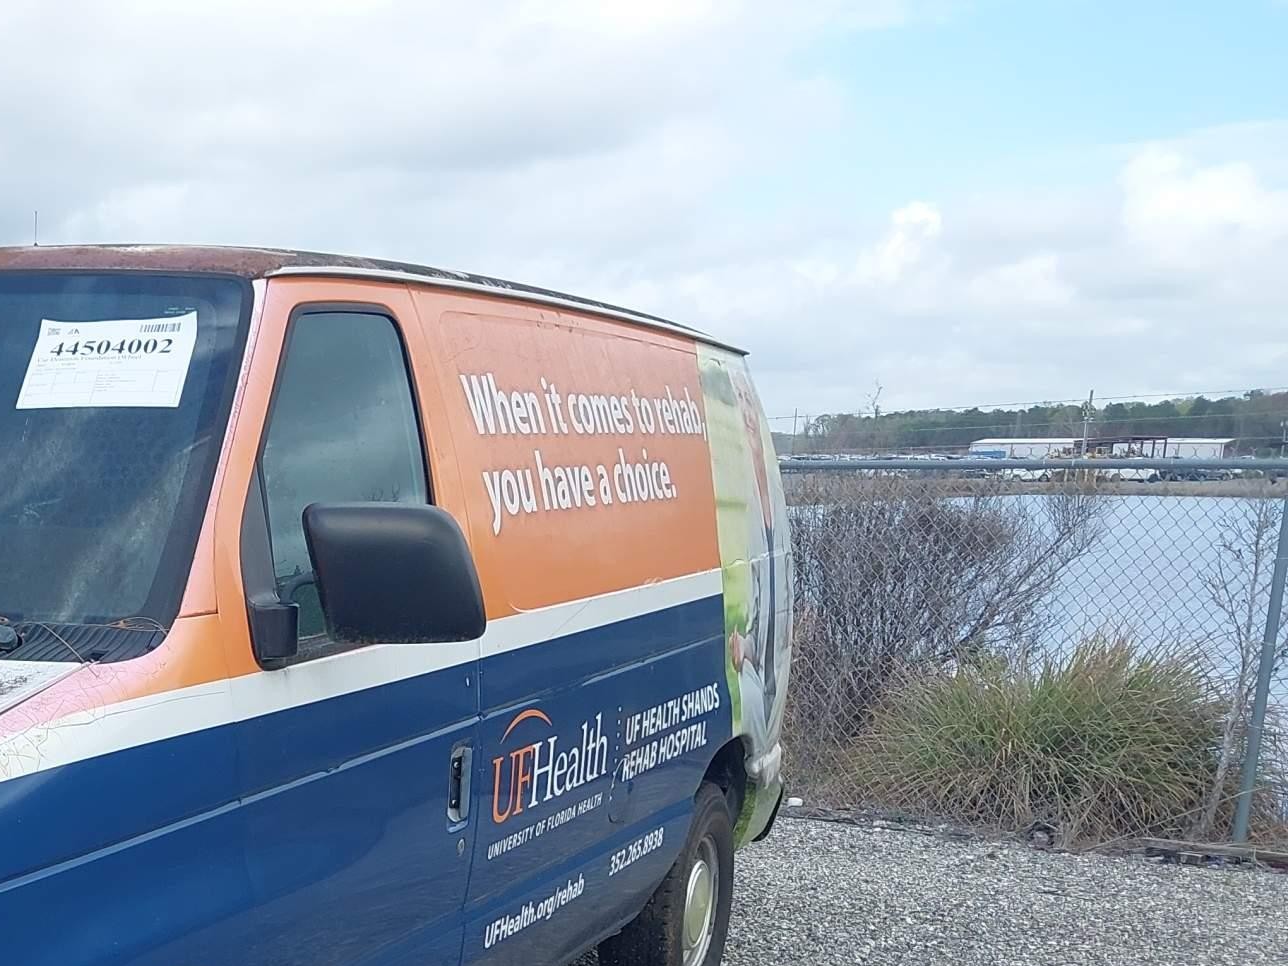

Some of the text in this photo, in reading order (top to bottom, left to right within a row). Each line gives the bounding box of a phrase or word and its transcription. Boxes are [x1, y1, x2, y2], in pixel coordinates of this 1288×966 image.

[50, 338, 174, 356] 44504002
[459, 373, 707, 441] When it comes to rehab,
[482, 448, 678, 536] you have a choice.
[625, 683, 720, 745] UF HEALTH SHANDS
[622, 722, 707, 783] REHAB HOSPITAL
[487, 792, 603, 860] UNIVERSITY OF FLORIDA HEALTH
[608, 827, 665, 877] 352.265.8938
[484, 873, 585, 949] UFHealth.org/rehab
